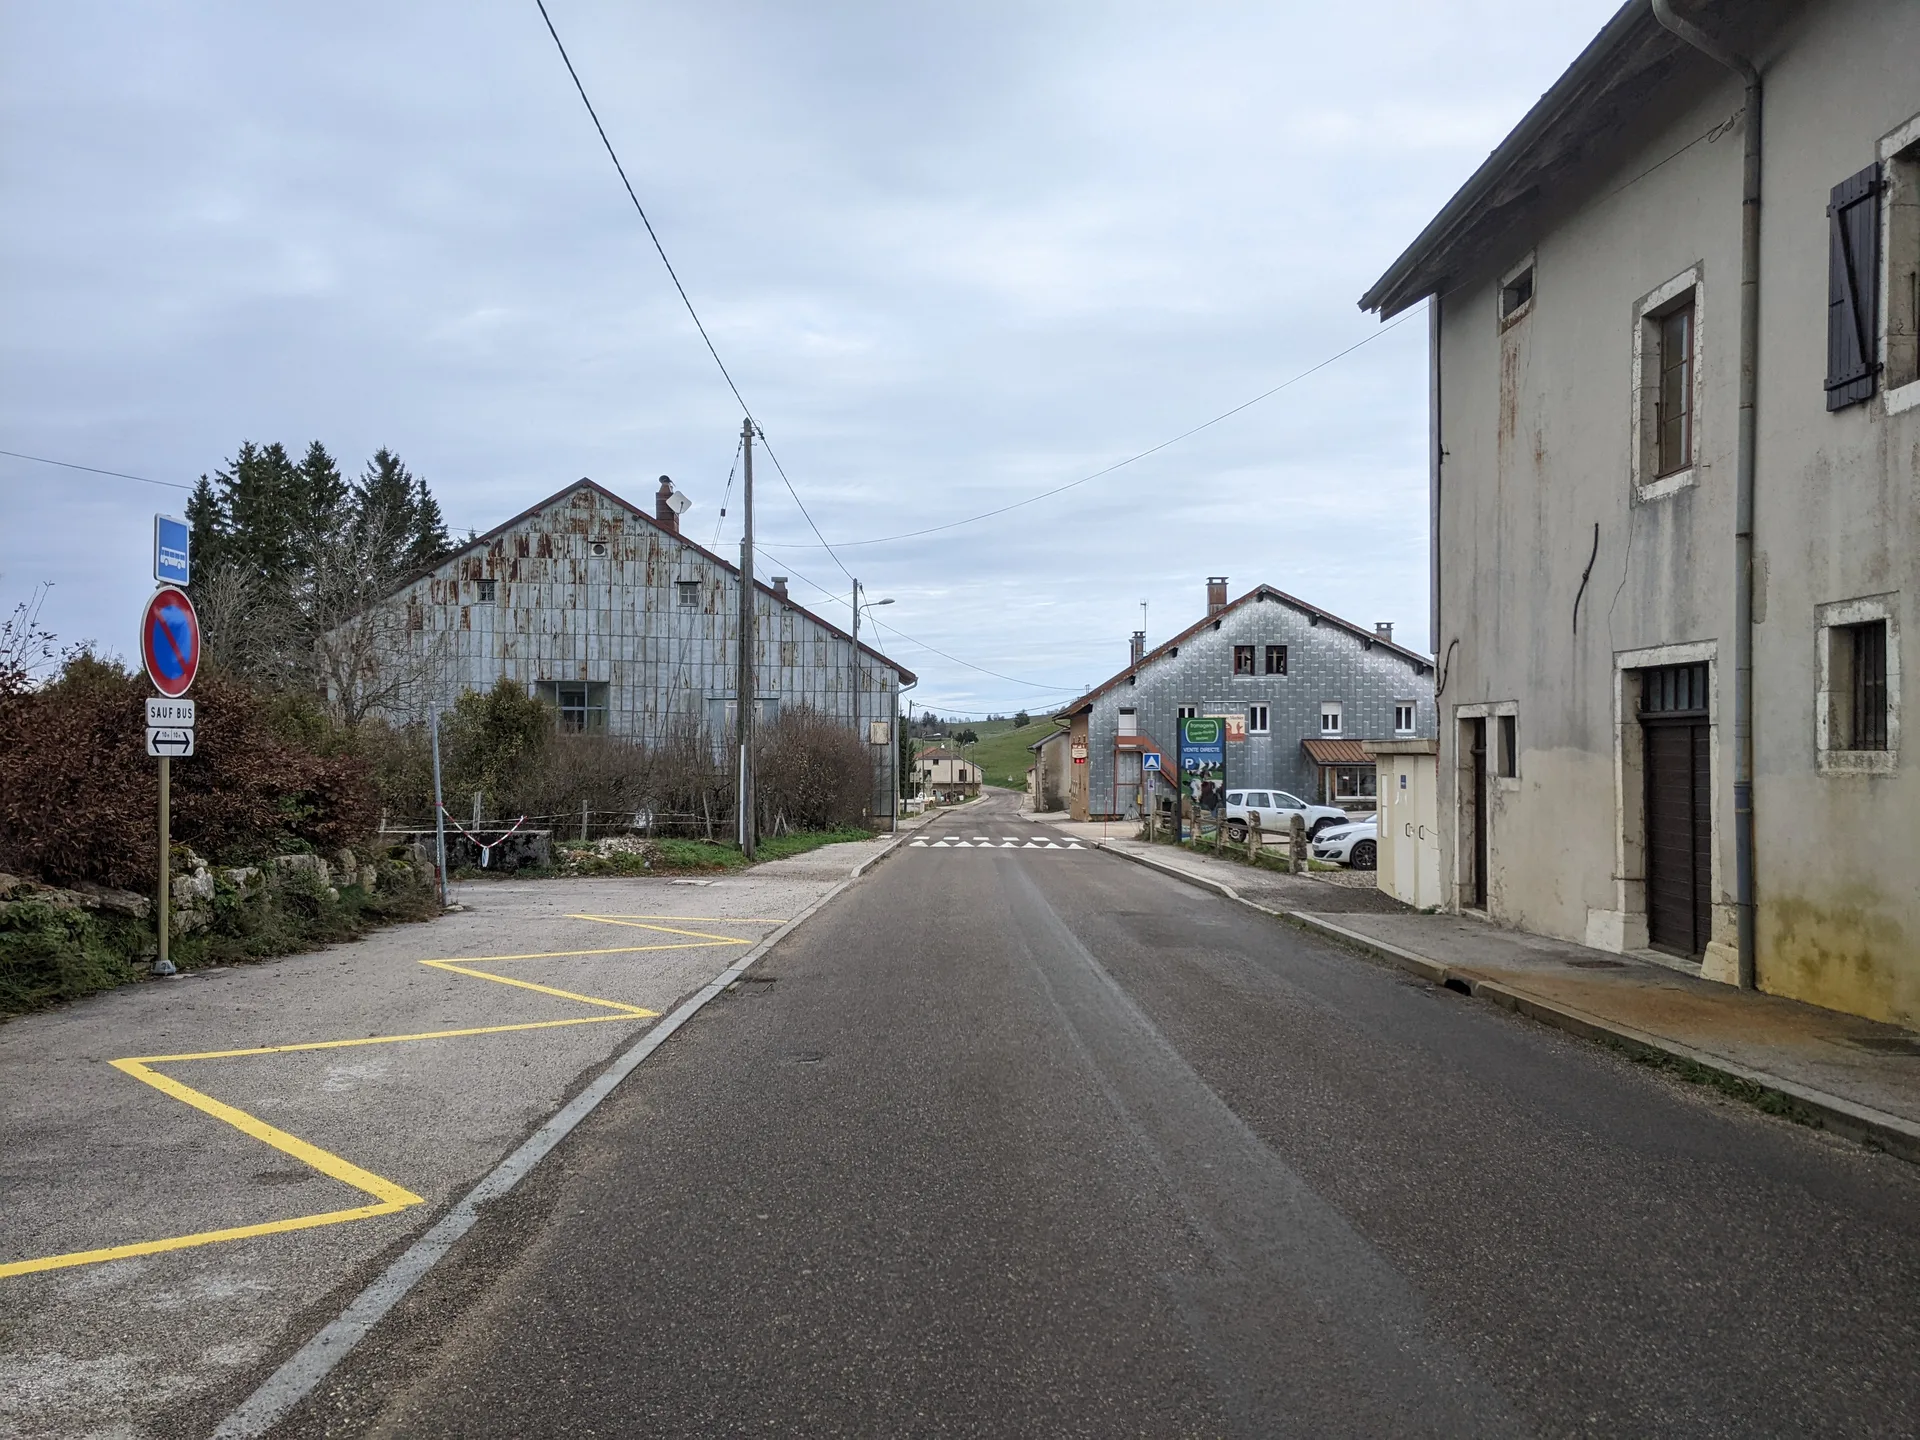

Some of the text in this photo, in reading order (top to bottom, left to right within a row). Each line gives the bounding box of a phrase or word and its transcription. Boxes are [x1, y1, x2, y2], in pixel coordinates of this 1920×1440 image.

[150, 706, 192, 718] SAUF BUS
[1185, 758, 1194, 769] P
